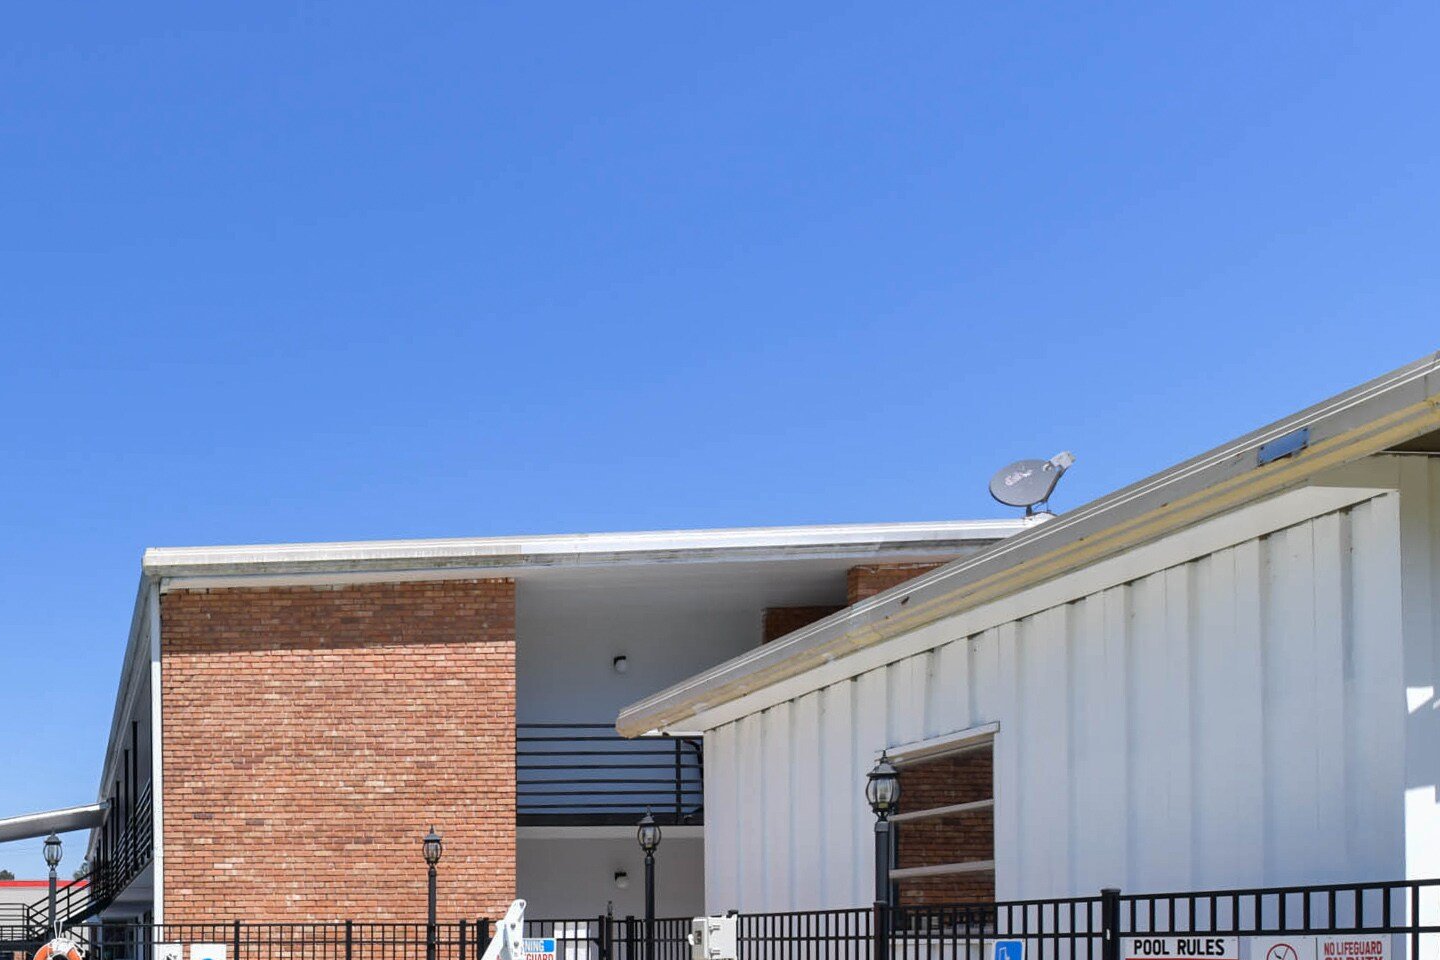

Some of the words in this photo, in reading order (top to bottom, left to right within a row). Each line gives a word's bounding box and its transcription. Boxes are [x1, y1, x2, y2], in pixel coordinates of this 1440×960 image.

[1134, 939, 1170, 955] POOL
[1177, 939, 1225, 956] RULES
[1324, 942, 1335, 955] NO
[1338, 941, 1383, 955] LIFEGUARD
